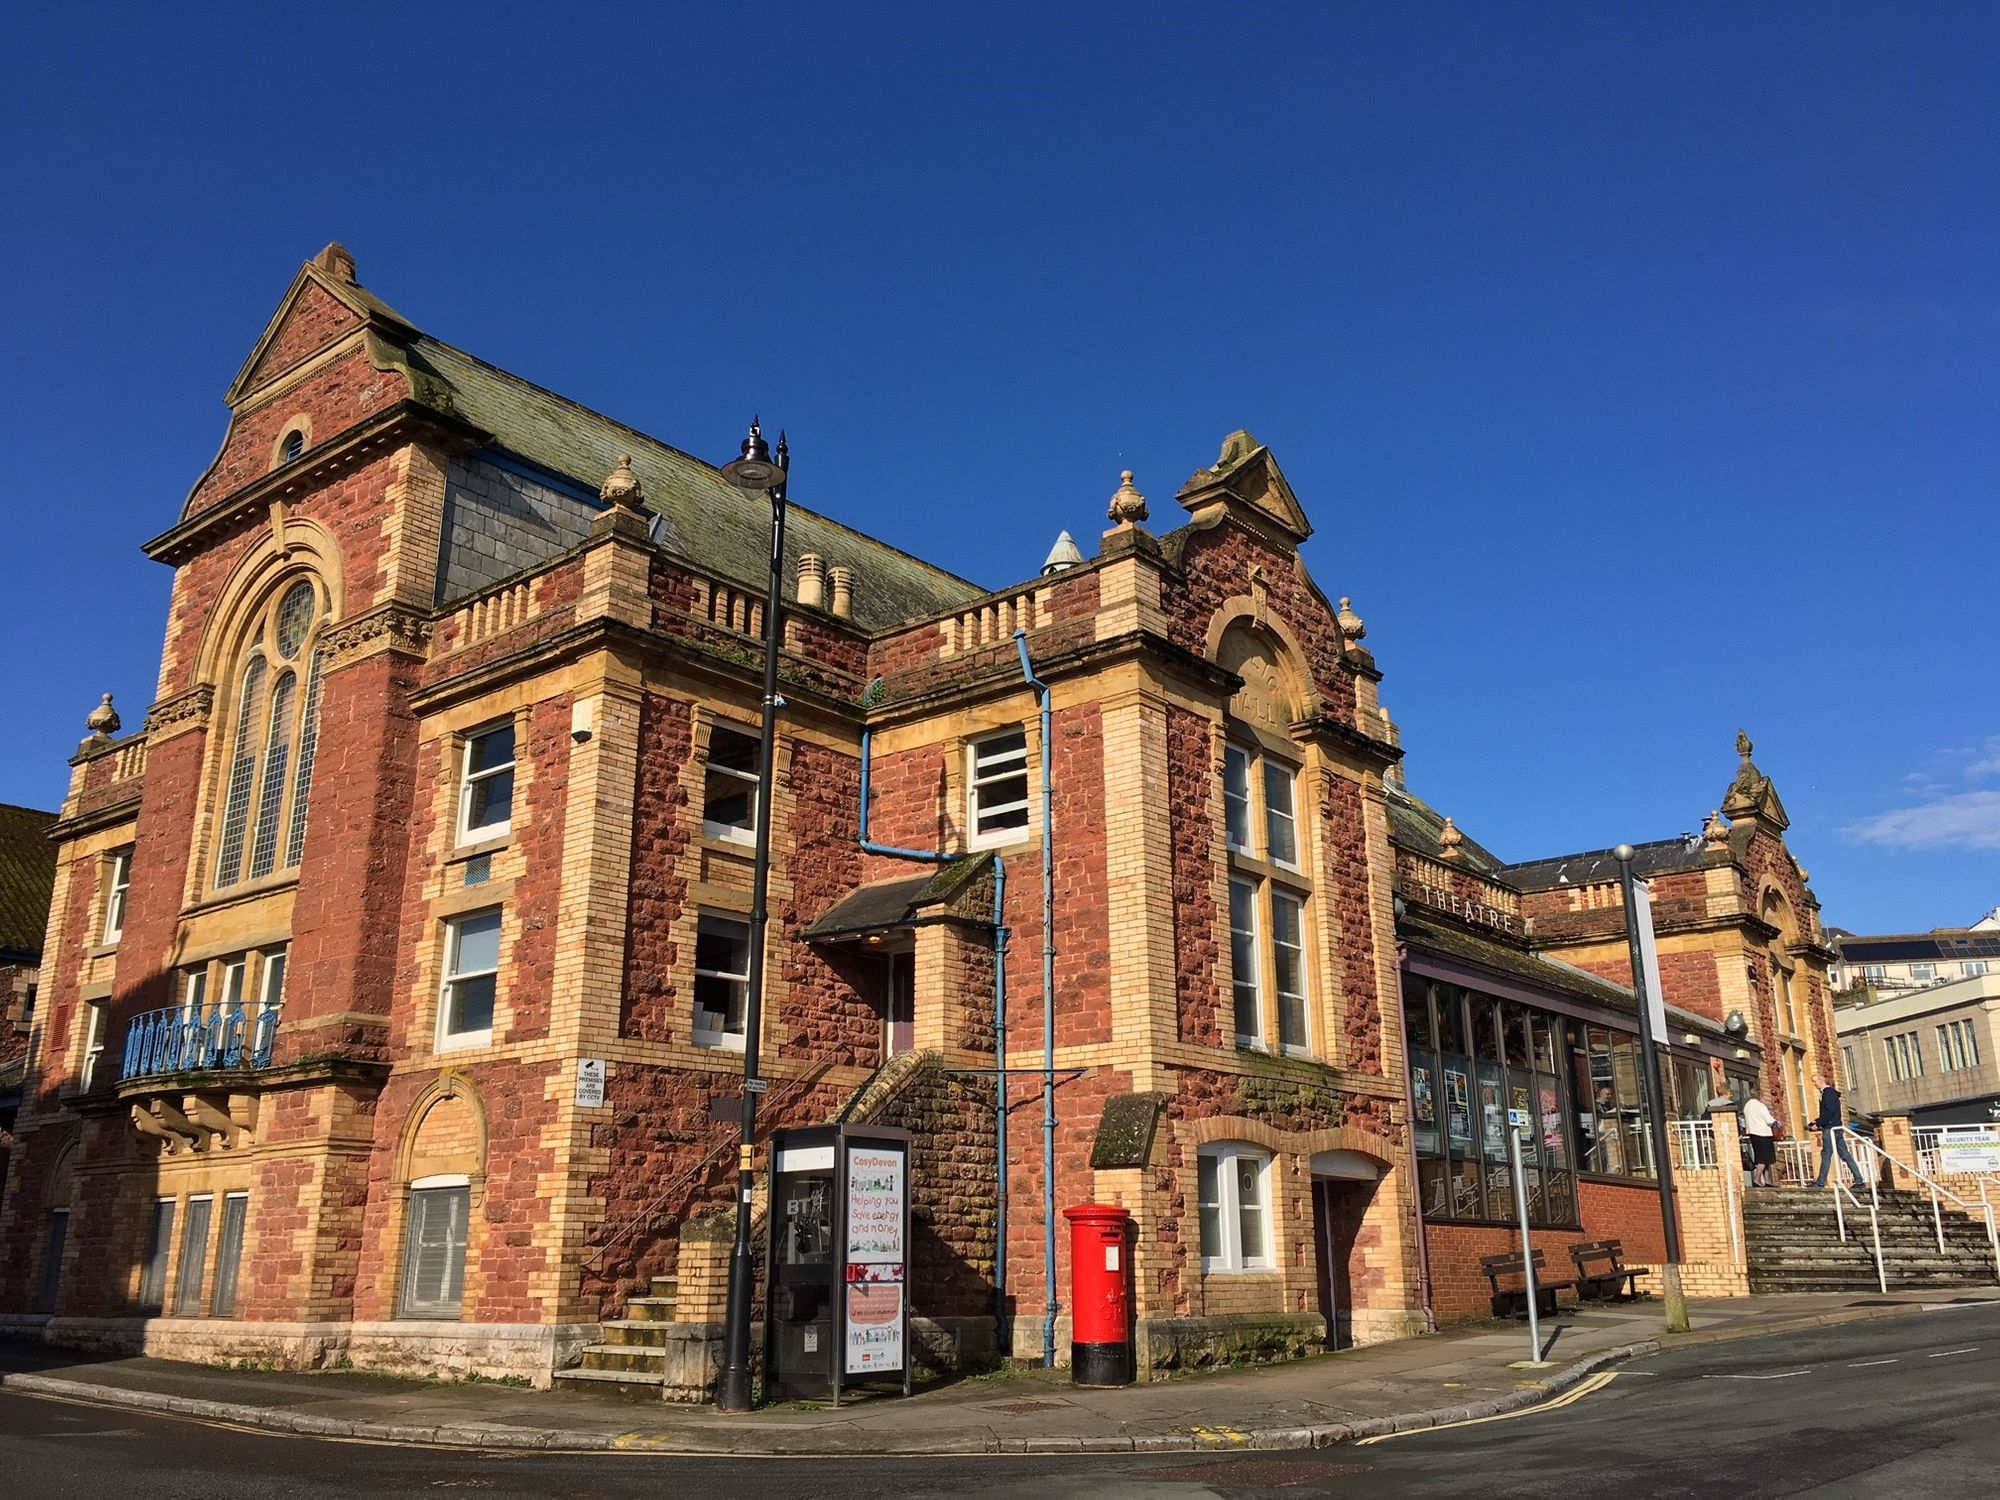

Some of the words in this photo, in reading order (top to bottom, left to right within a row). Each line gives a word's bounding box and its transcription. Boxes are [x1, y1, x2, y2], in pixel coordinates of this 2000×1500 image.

[1421, 884, 1514, 934] THEATRE
[853, 1156, 897, 1168] CosyDevon
[787, 1199, 810, 1215] BT
[851, 1194, 881, 1208] Helping
[872, 1211, 899, 1222] energy
[852, 1224, 869, 1234] and
[871, 1224, 898, 1239] money
